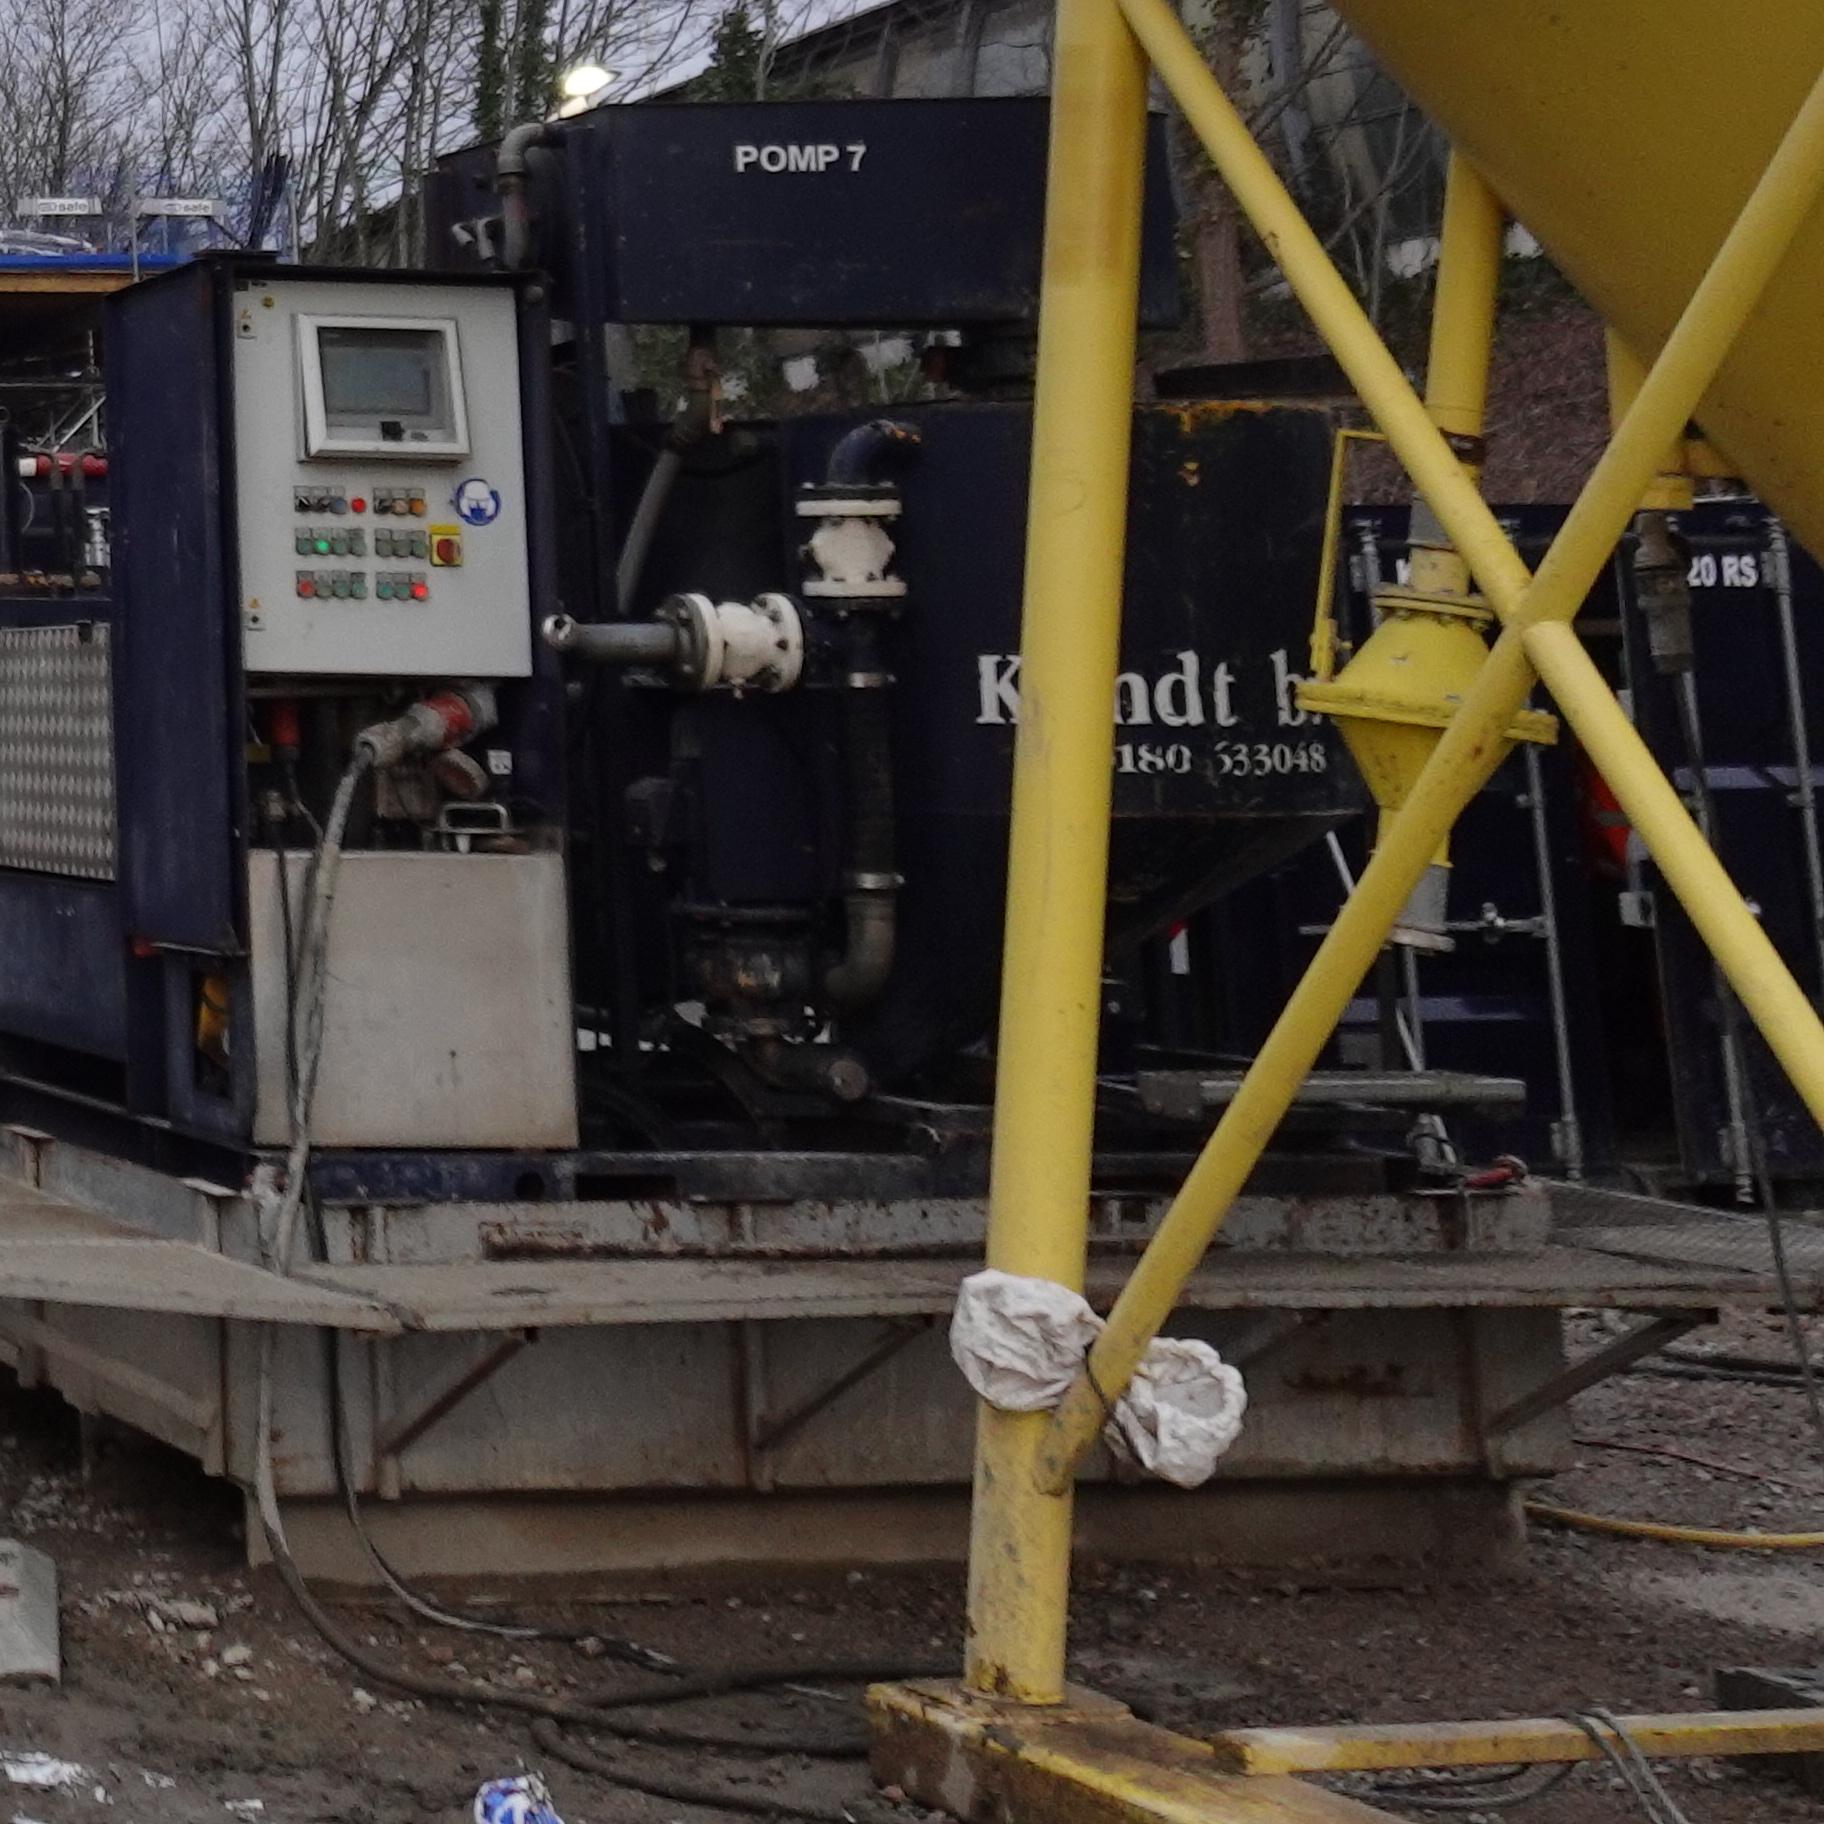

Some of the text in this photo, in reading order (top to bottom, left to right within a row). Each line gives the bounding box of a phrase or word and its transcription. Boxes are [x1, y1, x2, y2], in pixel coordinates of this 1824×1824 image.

[735, 144, 867, 173] POMP 7
[1722, 554, 1759, 587] RS
[975, 649, 1239, 727] Kndt
[1115, 743, 1192, 774] 180
